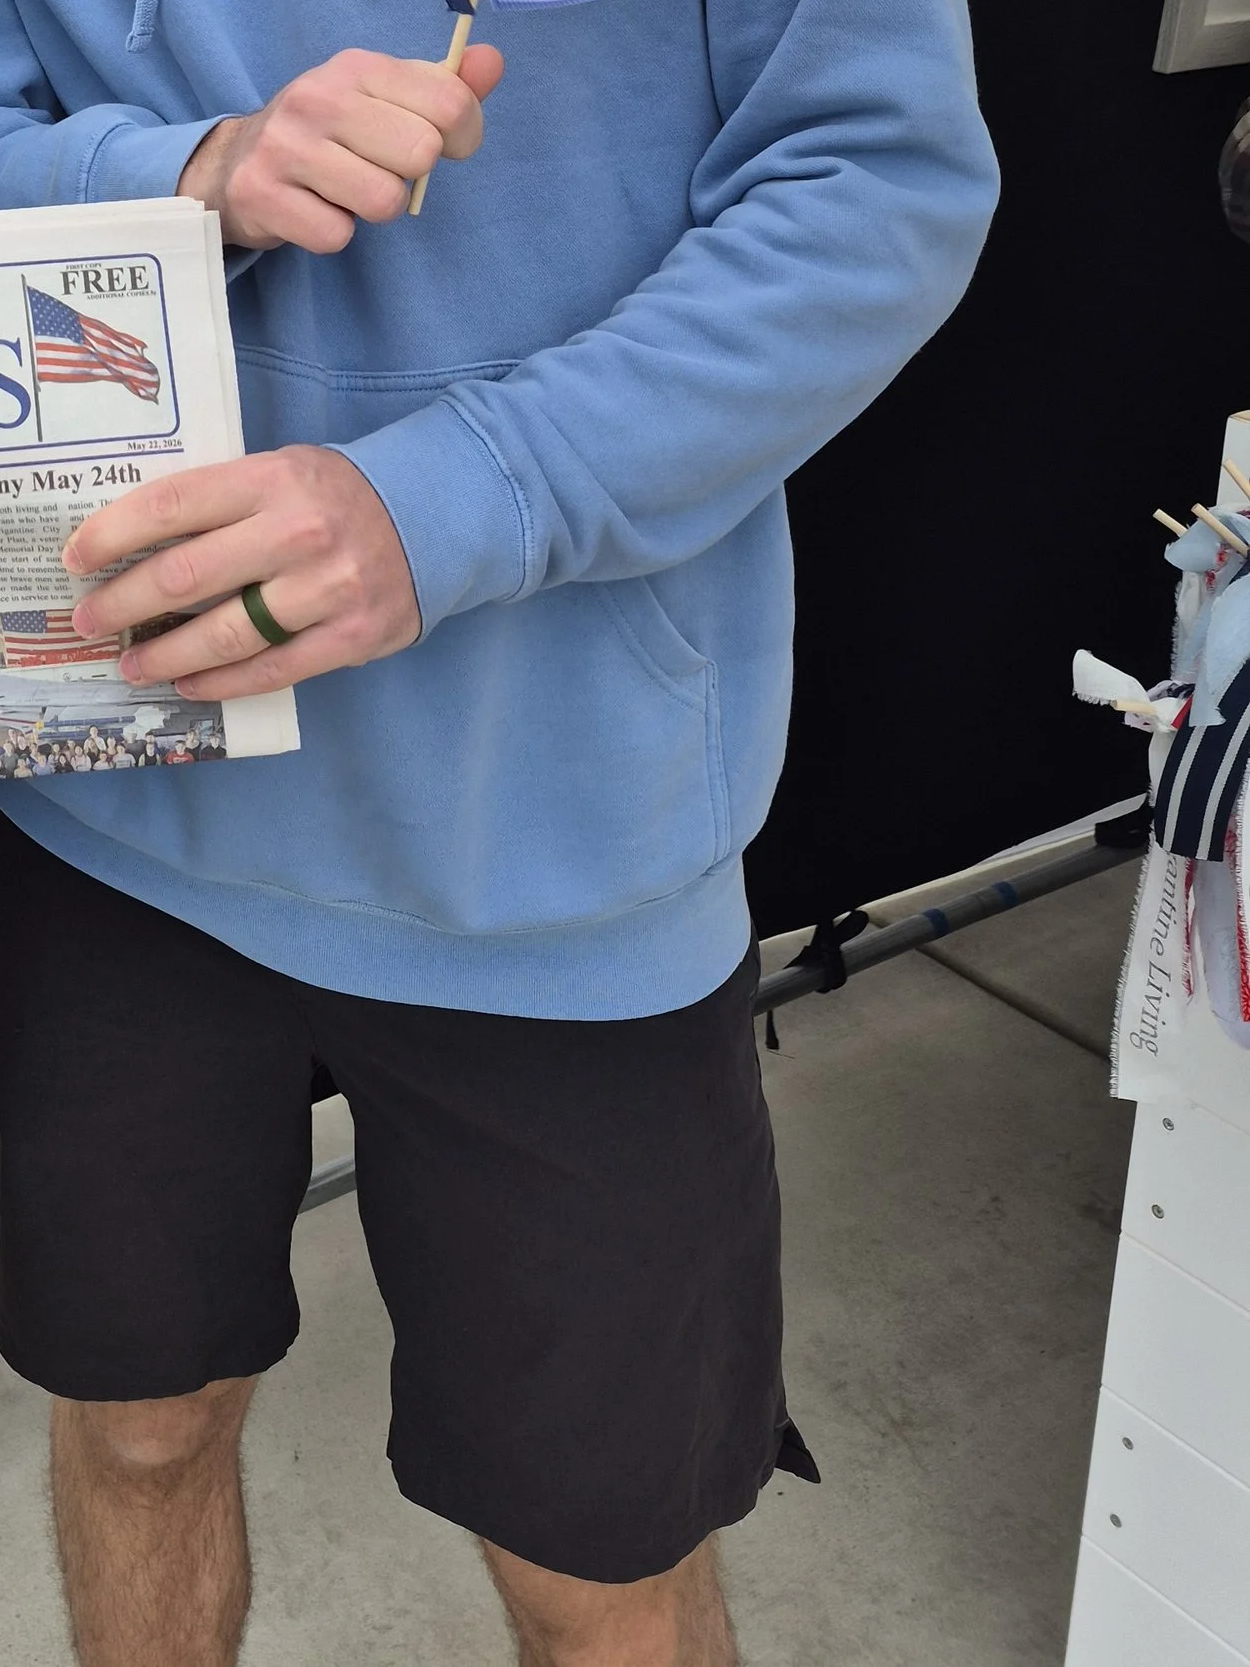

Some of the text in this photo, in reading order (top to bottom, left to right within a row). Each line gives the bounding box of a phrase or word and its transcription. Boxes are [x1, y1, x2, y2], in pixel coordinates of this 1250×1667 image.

[60, 266, 149, 296] FREE
[128, 439, 182, 452] May 22, 2026
[30, 470, 83, 494] May
[90, 463, 142, 487] 24th
[1129, 959, 1172, 1058] Living
